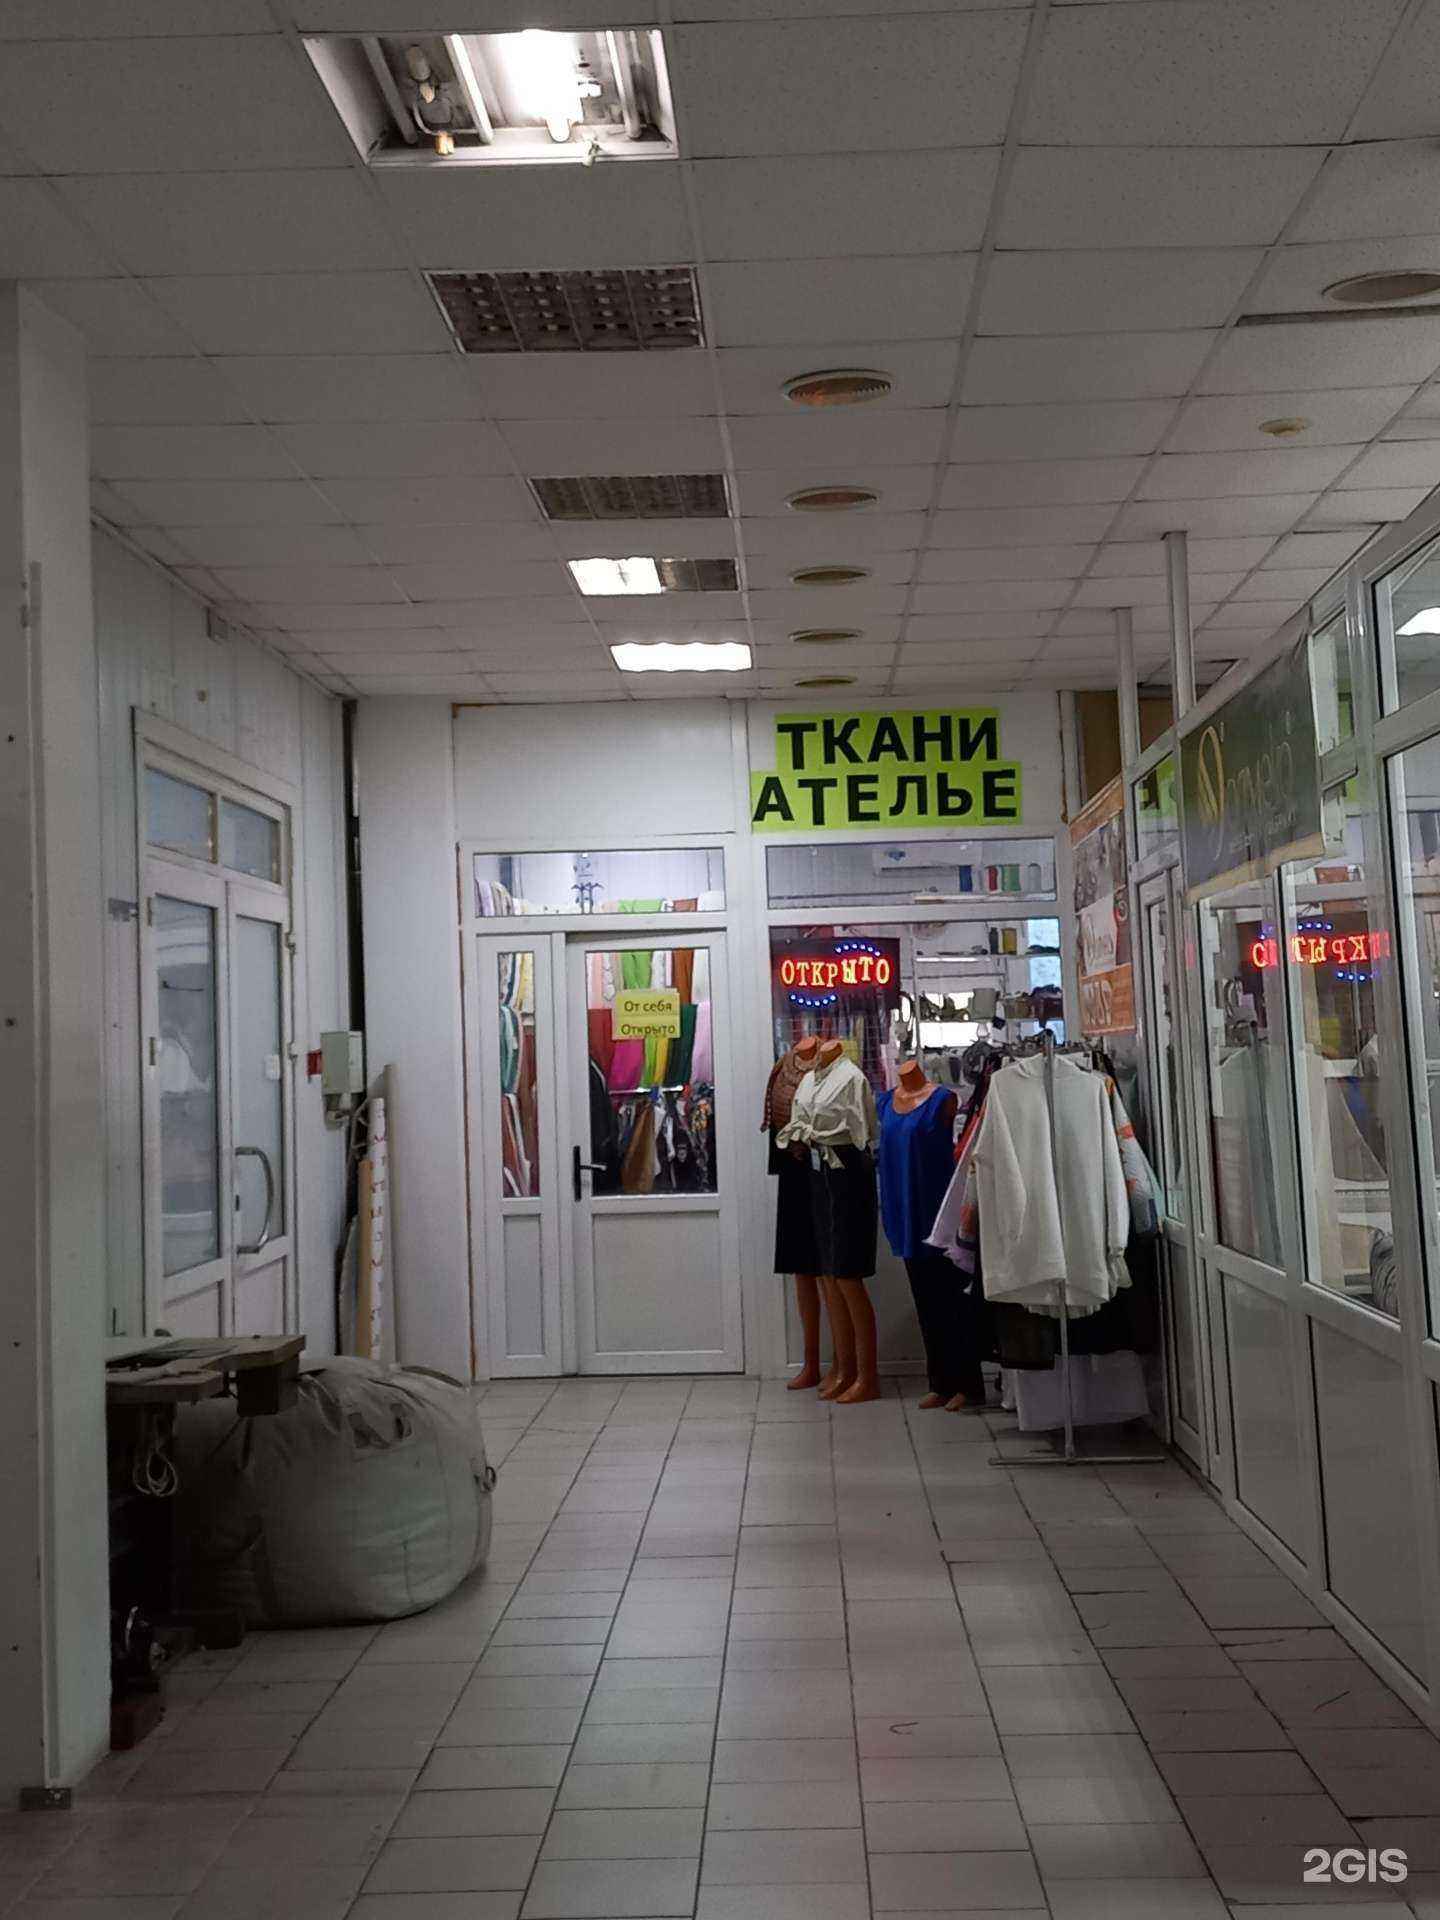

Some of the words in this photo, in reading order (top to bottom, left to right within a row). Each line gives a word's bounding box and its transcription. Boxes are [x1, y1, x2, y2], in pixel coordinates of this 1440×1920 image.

[777, 715, 998, 770] ТКАНИ
[752, 768, 1017, 826] АТЕЛЬЕ
[781, 956, 890, 987] ОТКРЫТО
[624, 1000, 640, 1012] От
[642, 998, 672, 1012] себя
[621, 1023, 676, 1036] Открыто
